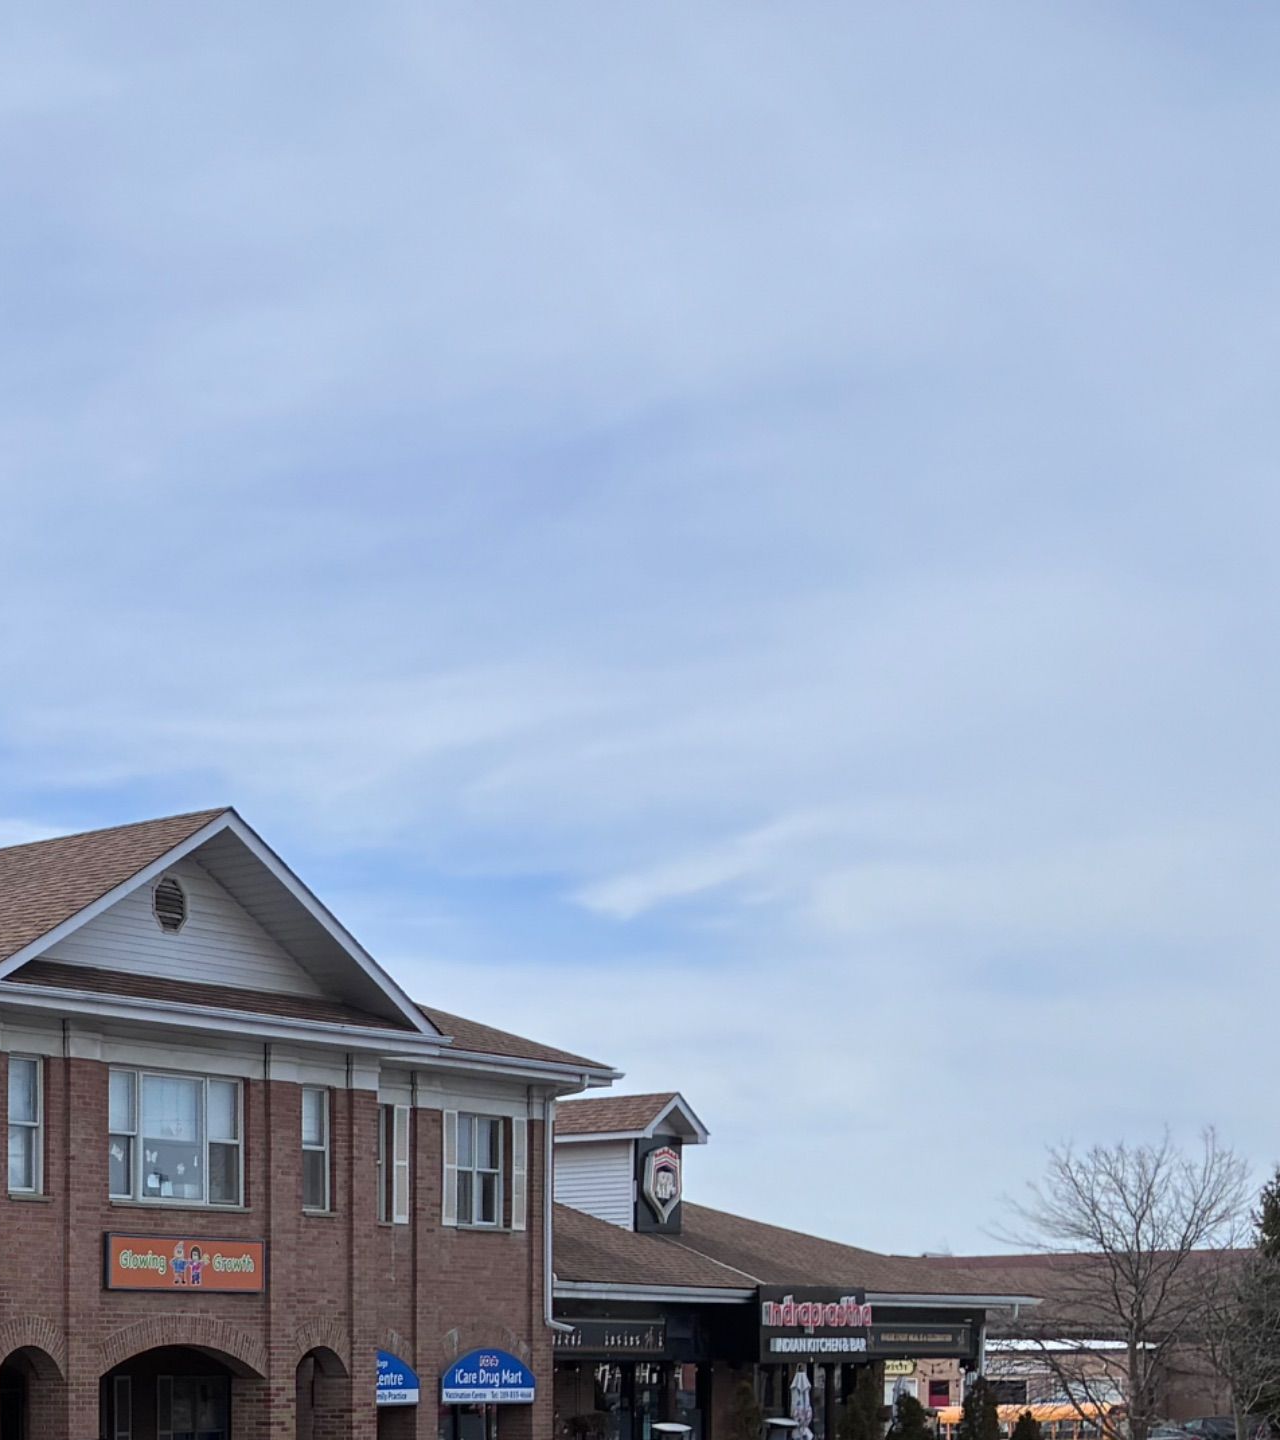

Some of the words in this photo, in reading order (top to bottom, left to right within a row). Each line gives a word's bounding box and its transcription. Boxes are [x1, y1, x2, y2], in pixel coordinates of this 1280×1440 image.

[119, 1249, 167, 1275] Glowing
[212, 1252, 255, 1273] Growth
[455, 1368, 478, 1385] iCare
[479, 1369, 500, 1387] Drug
[502, 1369, 523, 1384] Mart
